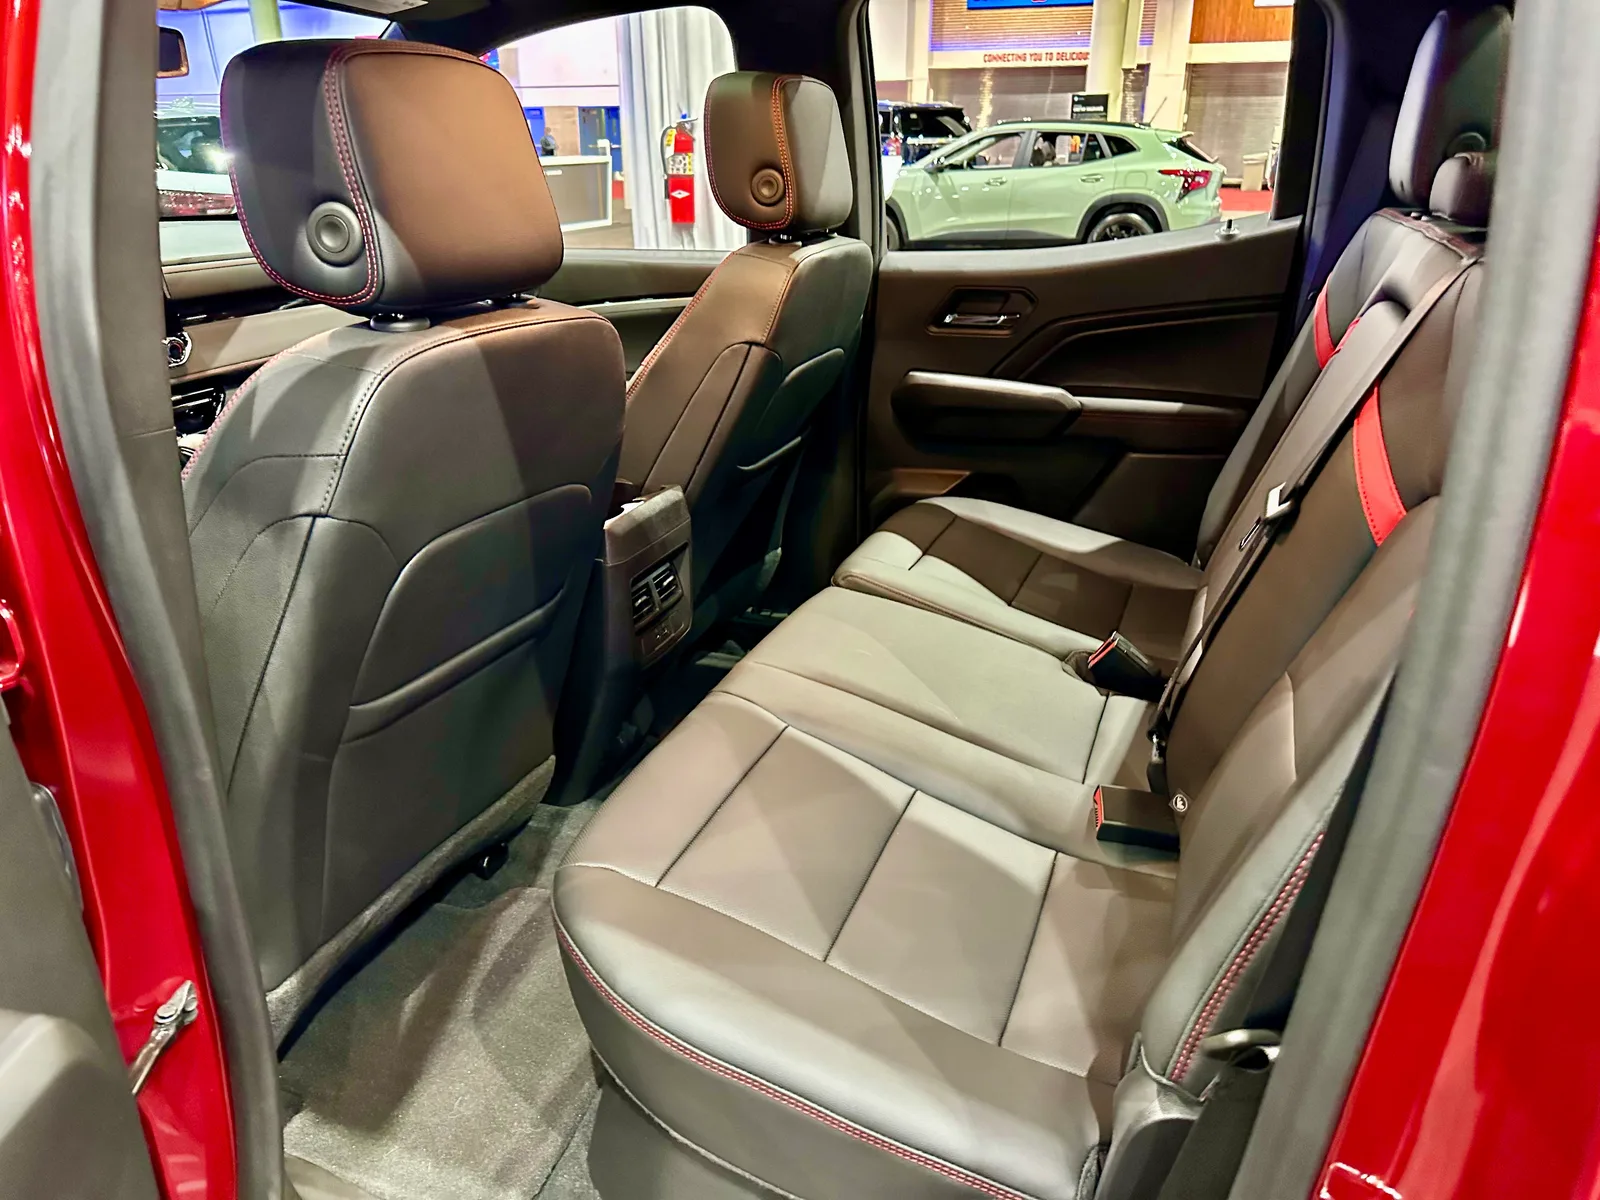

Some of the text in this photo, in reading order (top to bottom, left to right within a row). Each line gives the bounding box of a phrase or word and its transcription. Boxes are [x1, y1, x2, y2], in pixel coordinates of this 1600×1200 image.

[983, 53, 1027, 63] CONNECTING
[1029, 52, 1043, 62] YOU
[1045, 52, 1054, 61] TO
